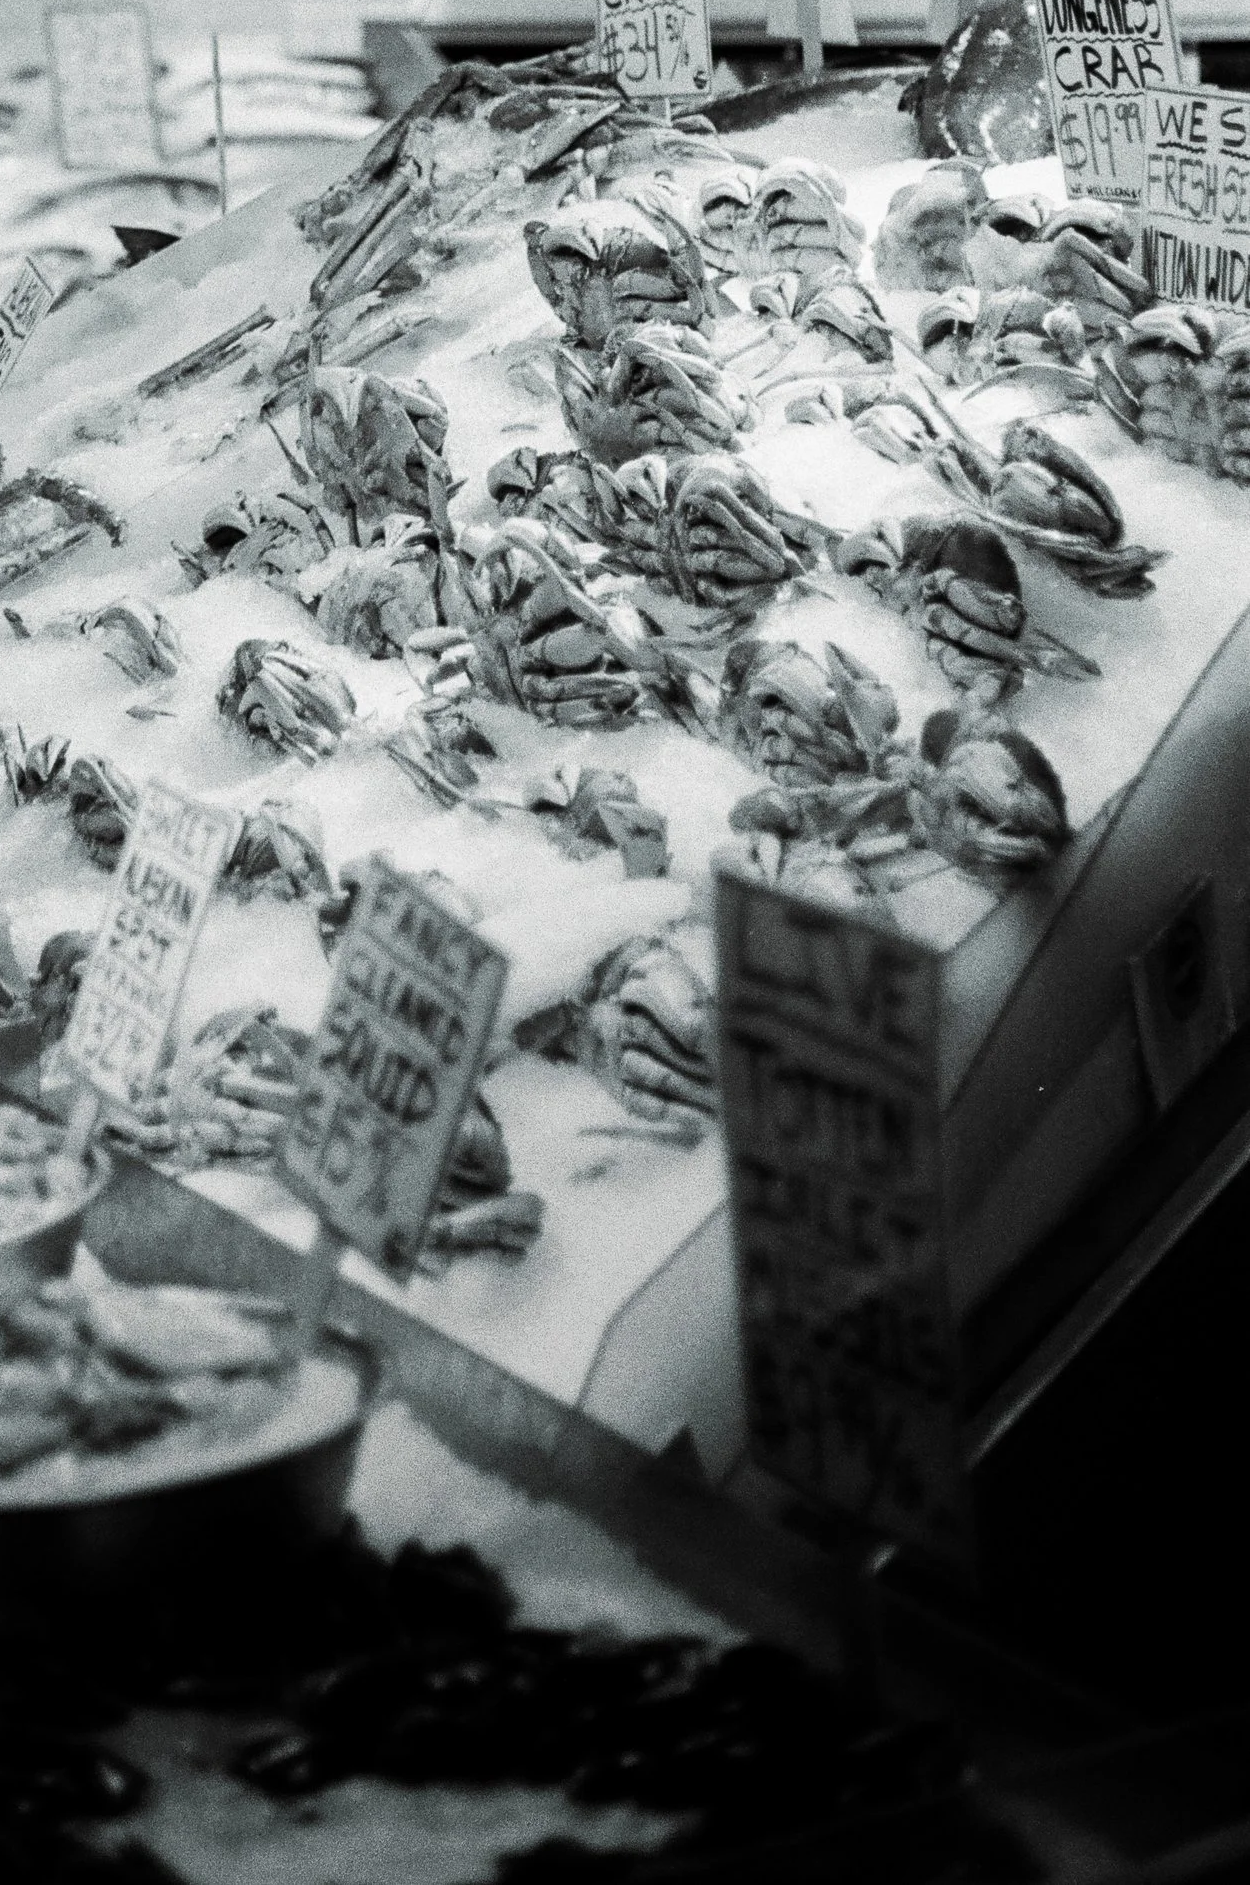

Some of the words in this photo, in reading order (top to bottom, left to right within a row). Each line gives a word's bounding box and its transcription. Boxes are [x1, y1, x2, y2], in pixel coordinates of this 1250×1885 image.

[1059, 101, 1145, 179] $19.99
[1155, 99, 1208, 143] WE
[1204, 244, 1250, 310] WID
